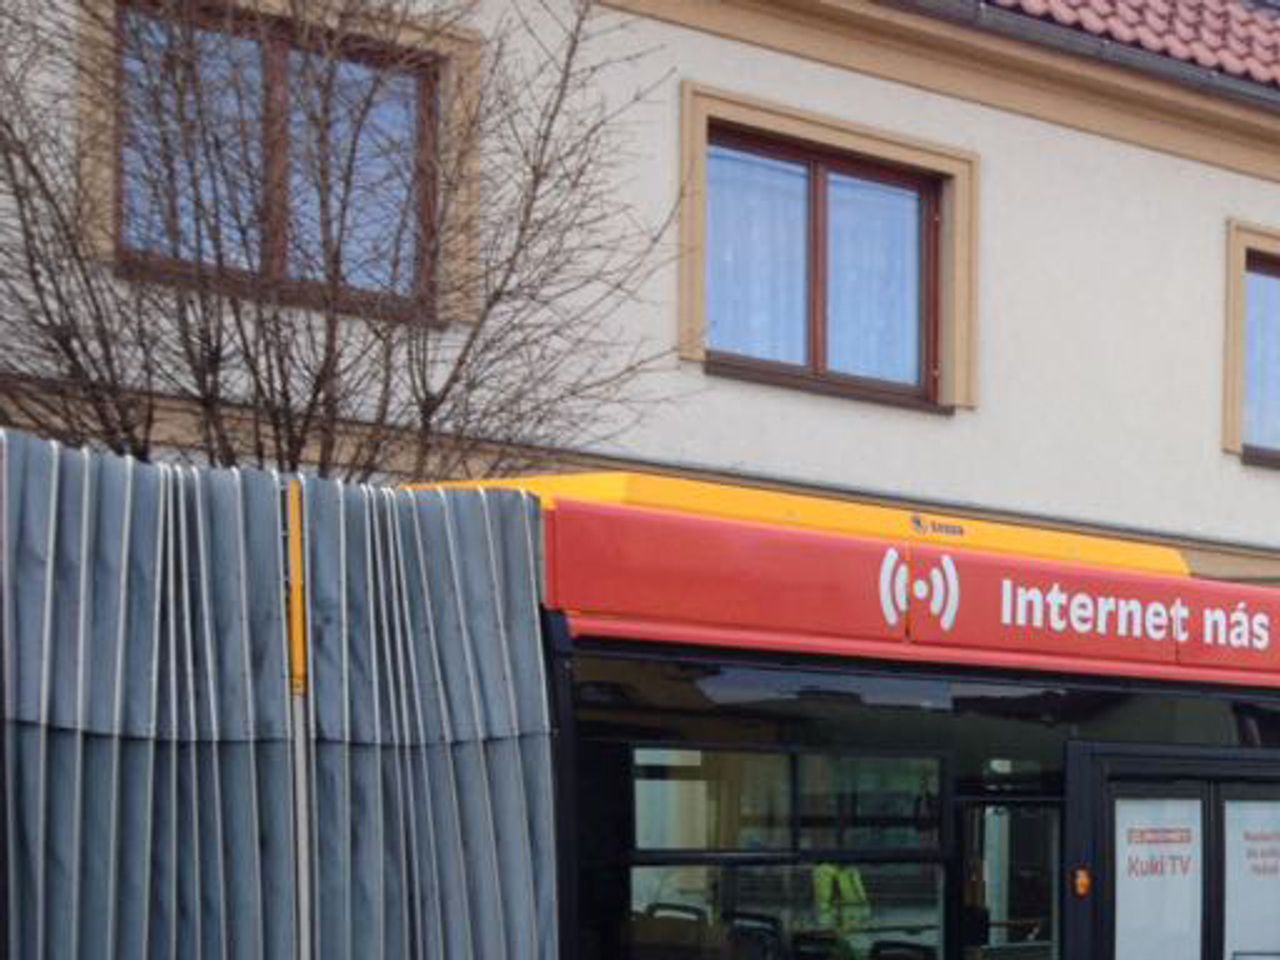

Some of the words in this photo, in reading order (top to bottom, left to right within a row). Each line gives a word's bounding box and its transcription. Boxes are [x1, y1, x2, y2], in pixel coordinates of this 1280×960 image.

[1000, 578, 1189, 641] Internet
[1203, 599, 1270, 649] nás
[1169, 855, 1192, 877] TV
